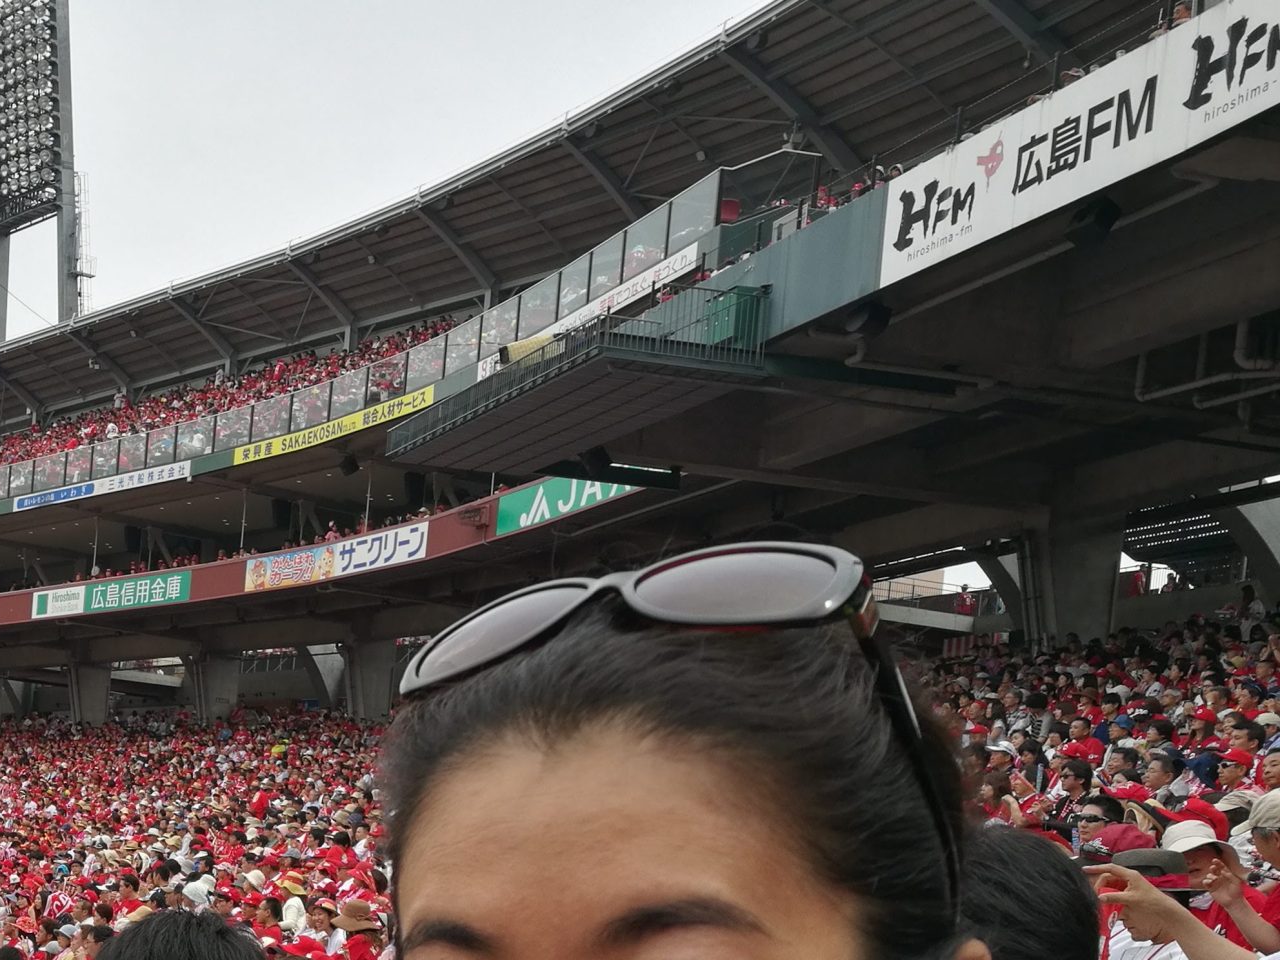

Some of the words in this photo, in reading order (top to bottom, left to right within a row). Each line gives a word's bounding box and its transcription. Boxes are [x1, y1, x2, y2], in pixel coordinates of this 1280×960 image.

[1011, 75, 1158, 197] 広島FM
[892, 178, 976, 252] HFM
[907, 224, 973, 262] hiroshima-fm
[281, 420, 344, 454] SAKAEKOSAN
[362, 391, 427, 427] 総合人材サービス
[270, 548, 314, 572] がんばれ
[339, 525, 425, 572] サニクリーン
[91, 575, 182, 609] 広島信用金庫
